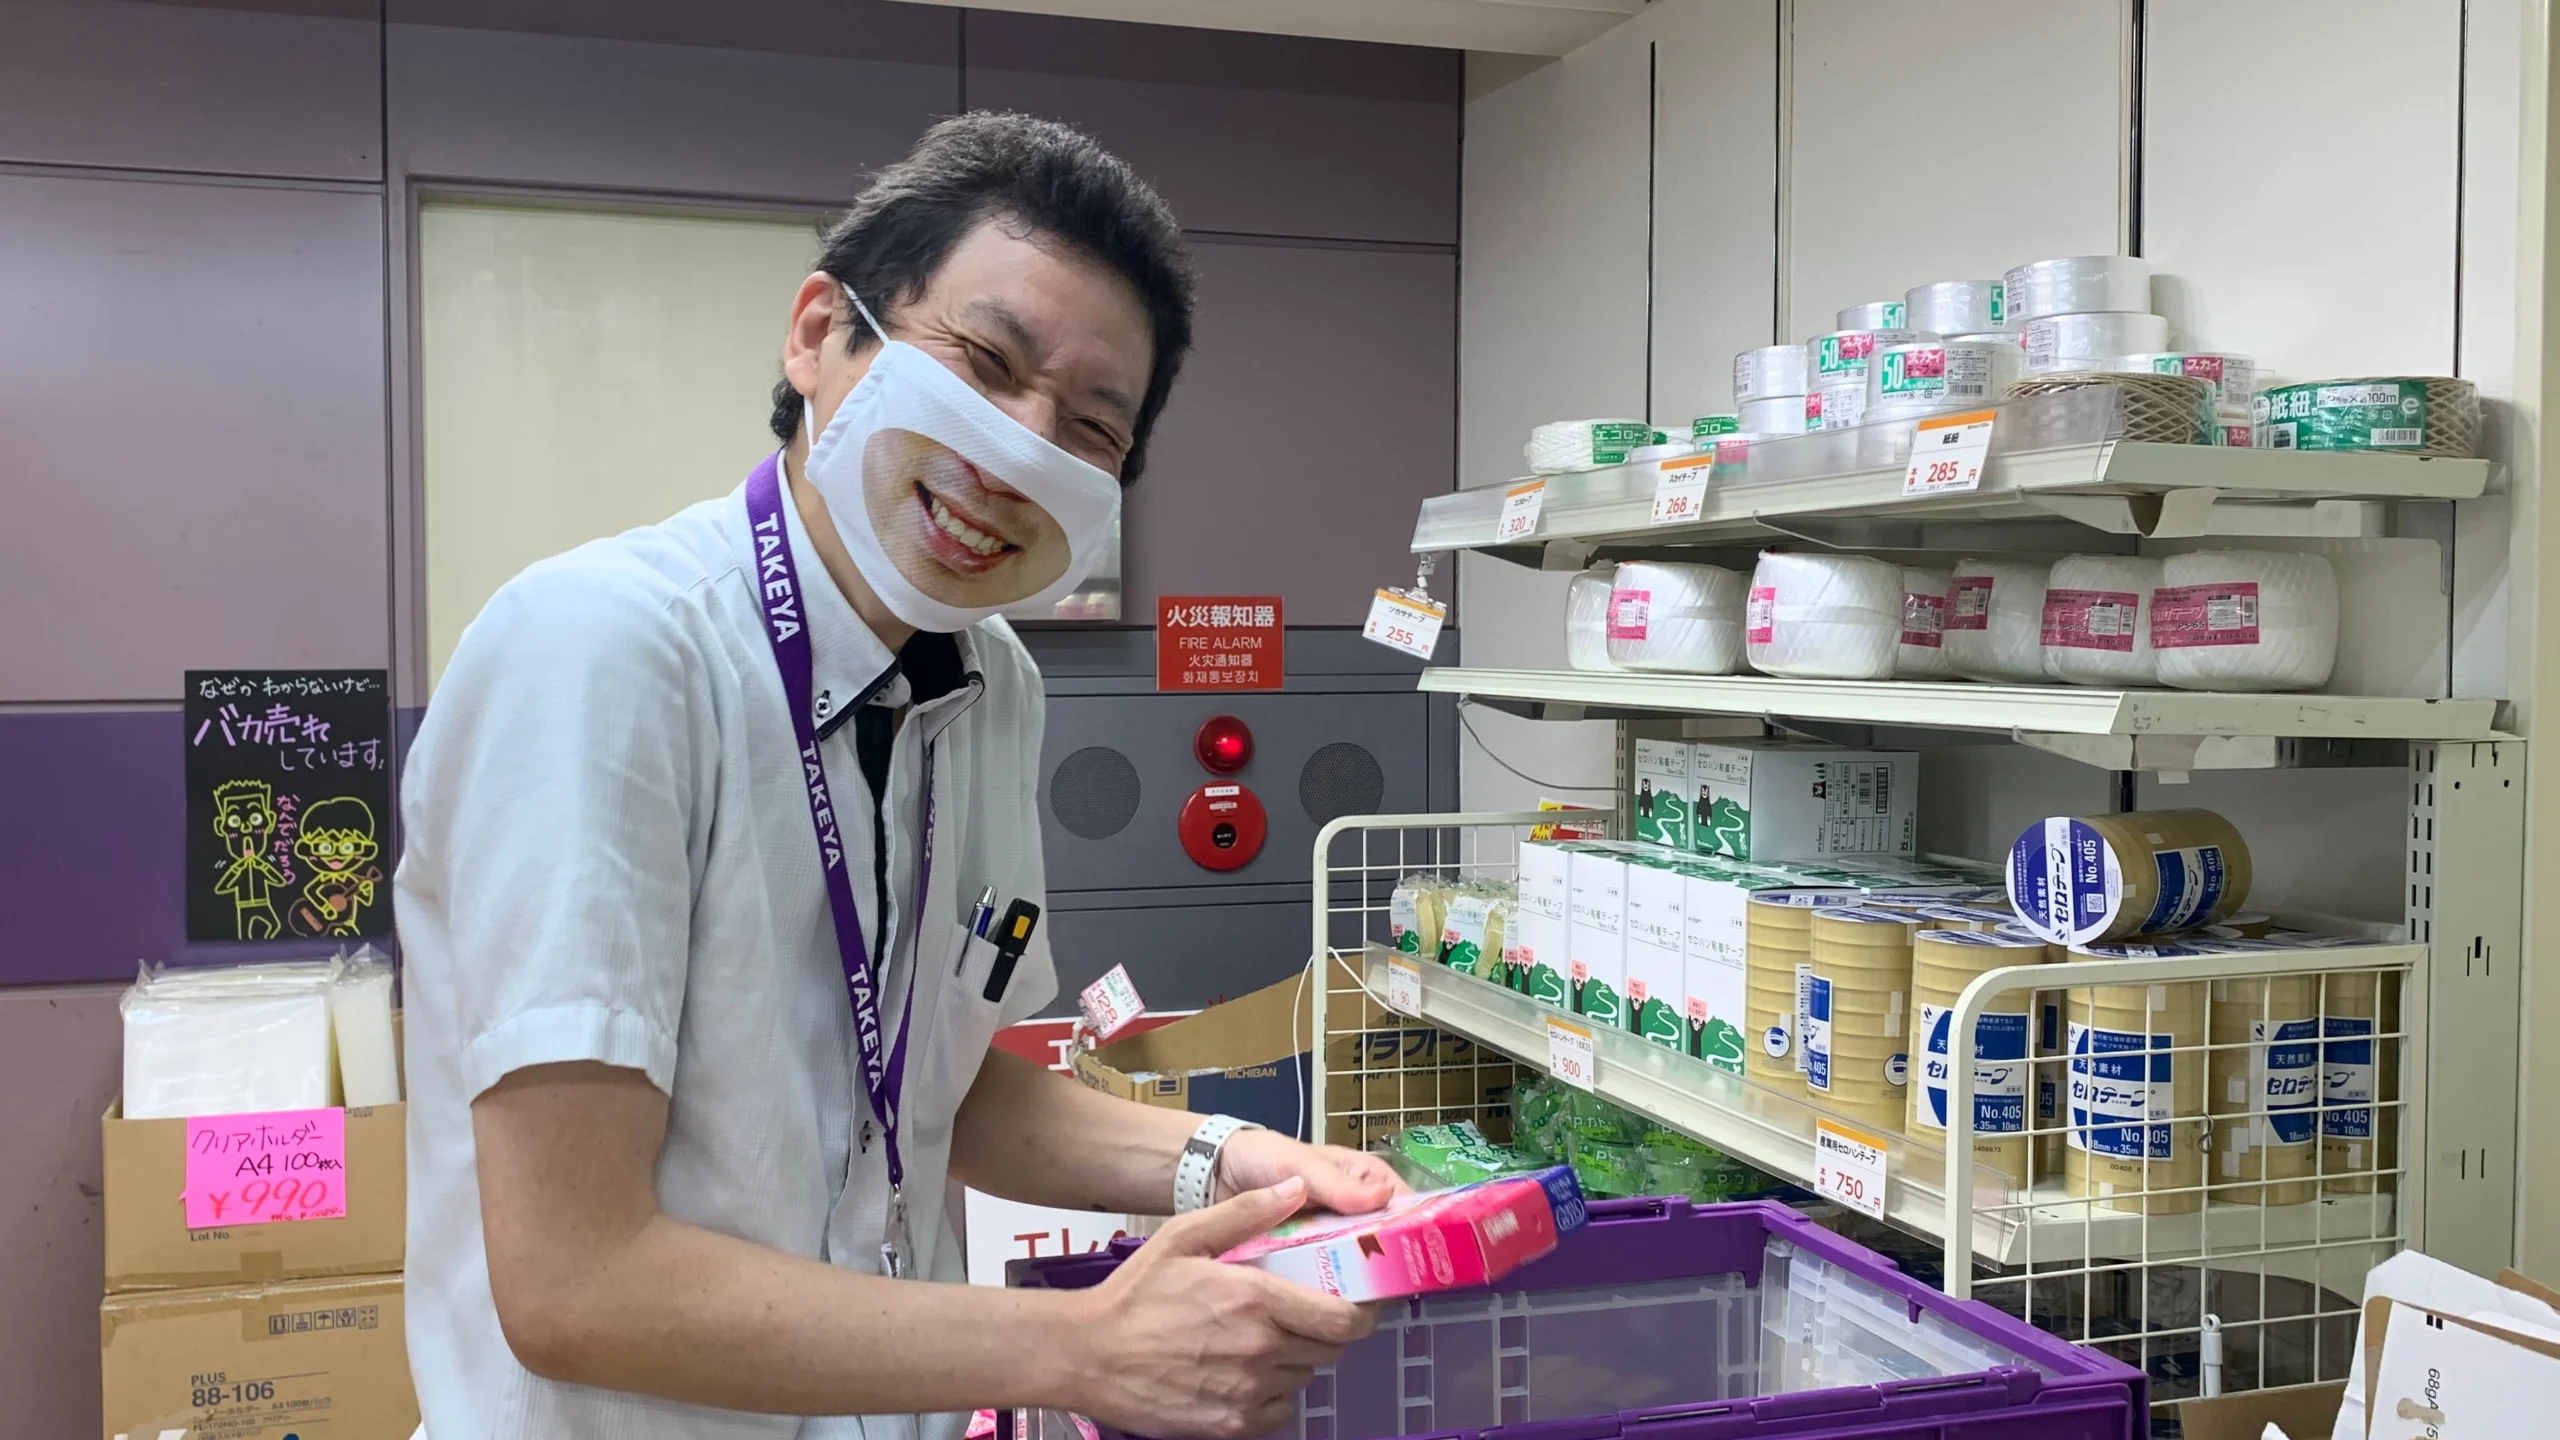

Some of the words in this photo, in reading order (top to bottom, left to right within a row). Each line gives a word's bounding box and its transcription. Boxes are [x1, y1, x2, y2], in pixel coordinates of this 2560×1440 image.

[1821, 339, 1837, 371] 50
[1883, 354, 1904, 391] 50
[2271, 390, 2310, 419] 紙紐
[1595, 430, 1650, 441] エコロープ
[1668, 471, 1697, 484] スカイテープ
[1926, 460, 1959, 483] 285
[1967, 468, 1977, 480] 円
[1666, 496, 1688, 515] 268
[1508, 516, 1526, 532] 320
[754, 512, 801, 644] TAKEYA
[1166, 605, 1275, 628] 火災報知器
[1388, 604, 1426, 624] ツカサテープ
[2177, 620, 2205, 630] PS-65
[1179, 637, 1208, 649] FIRE
[1213, 637, 1262, 649] ALARM
[1386, 626, 1414, 646] 255
[1421, 643, 1429, 653] 円
[1188, 653, 1253, 668] 火灾通知器
[199, 677, 258, 699] なぜか
[1182, 670, 1259, 684] 화재통보장치
[193, 703, 331, 747] バカ売れ
[802, 740, 841, 871] TAKEYA
[273, 795, 300, 885] なんでだろう
[2083, 840, 2098, 884] No.405
[2051, 846, 2069, 924] セロテープ
[2036, 876, 2048, 920] 天然素材
[1096, 989, 1118, 1024] 128
[1400, 990, 1409, 1006] 90
[850, 963, 882, 1094] TAKEYA
[1550, 1030, 1574, 1045] セロハンテープ
[1224, 1067, 1277, 1079] NICHIBAN
[1562, 1057, 1581, 1078] 900
[1981, 1105, 2022, 1120] No.405
[1979, 1120, 1997, 1130] 35m
[2121, 1128, 2169, 1144] No.05
[1820, 1135, 1877, 1165] 産業用セロハンテープ
[2120, 1144, 2139, 1155] 35m
[2149, 1146, 2169, 1157] 0個入
[235, 1153, 275, 1177] A4
[1836, 1171, 1864, 1200] 750
[1873, 1196, 1881, 1210] 円
[190, 1231, 210, 1242] Lot
[213, 1230, 232, 1241] No.
[191, 1372, 227, 1386] PLUS
[192, 1381, 275, 1408] 88-106
